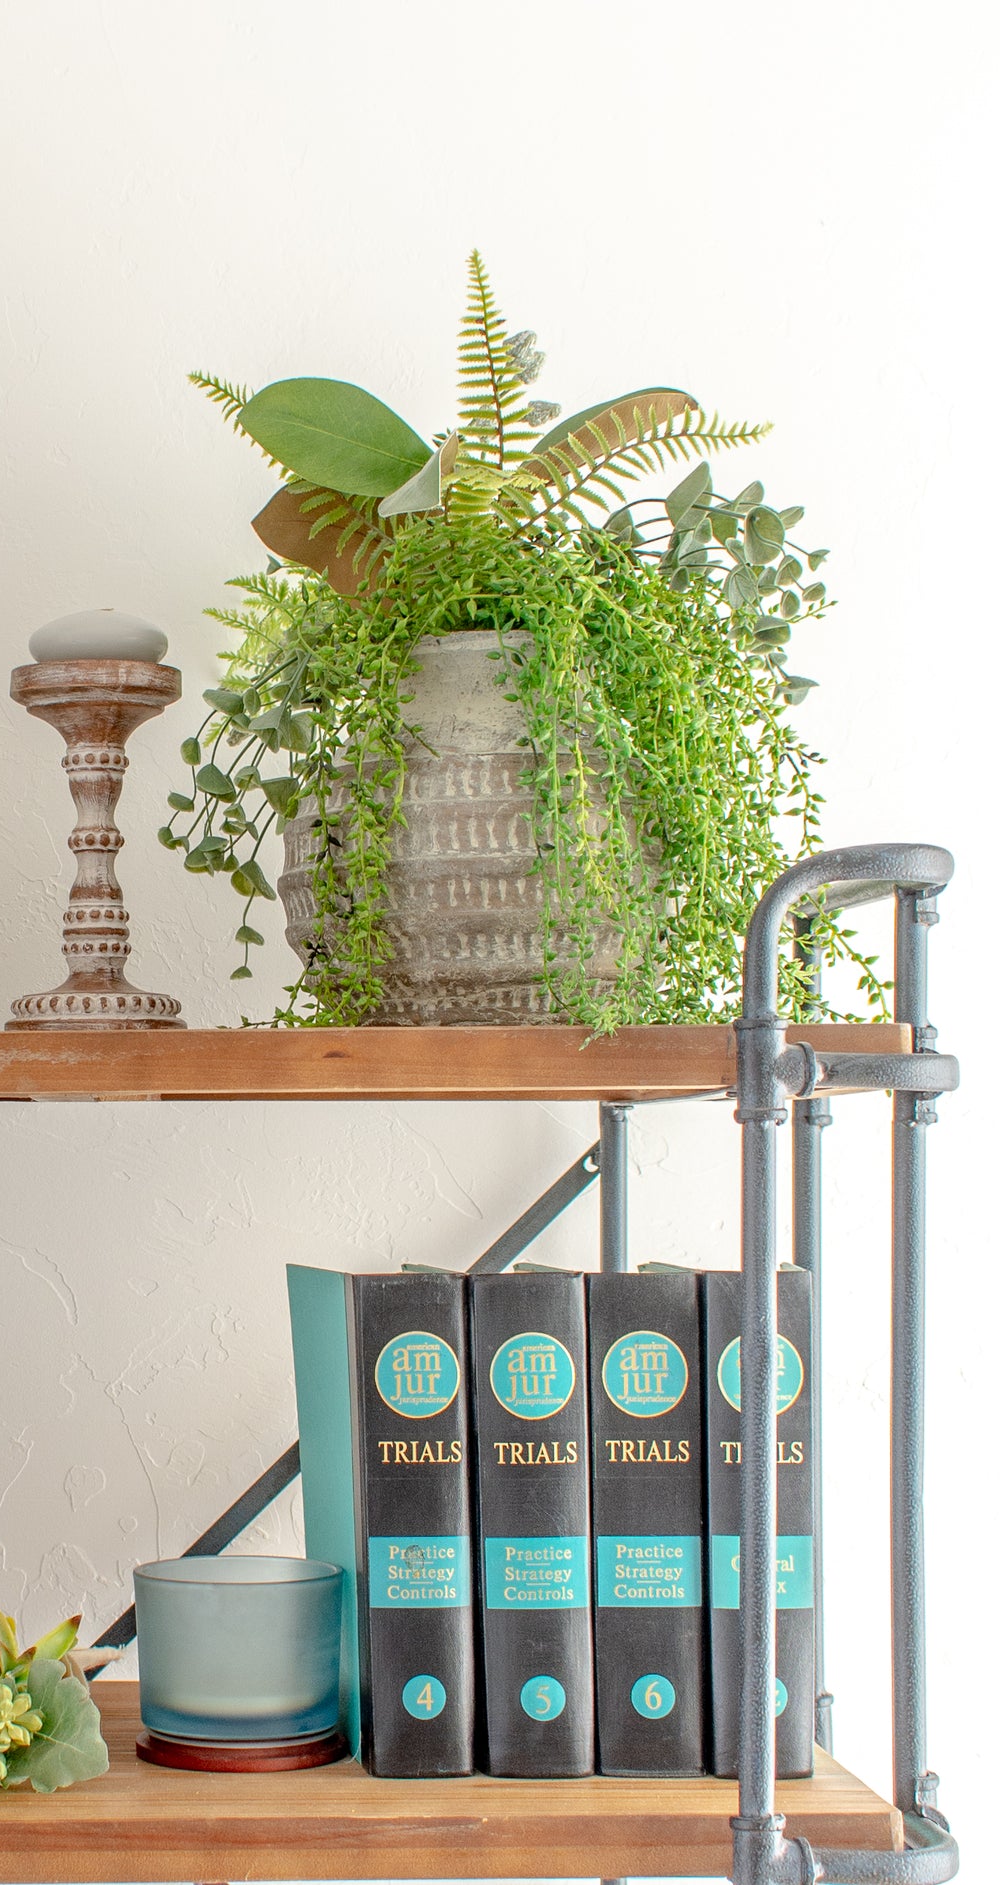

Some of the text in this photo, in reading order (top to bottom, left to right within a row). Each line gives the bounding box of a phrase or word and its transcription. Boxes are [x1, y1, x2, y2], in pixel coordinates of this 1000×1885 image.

[392, 1347, 442, 1372] am
[507, 1348, 557, 1373] am
[619, 1346, 669, 1371] am
[390, 1373, 441, 1401] jur
[505, 1374, 557, 1403] jur
[617, 1372, 669, 1400] jur
[378, 1440, 463, 1464] TRIALS
[493, 1441, 578, 1465] TRIALS
[605, 1440, 691, 1463] TRIALS
[505, 1546, 572, 1561] Practice
[615, 1544, 684, 1559] Practice
[387, 1565, 455, 1581] Strategy
[504, 1567, 572, 1583] Strategy
[615, 1564, 683, 1580] Strategy
[387, 1585, 457, 1600] Controls
[503, 1586, 574, 1601] Controls
[614, 1583, 685, 1599] Controls
[416, 1682, 434, 1712] 4
[535, 1685, 551, 1715] 5
[644, 1680, 662, 1710] 6
